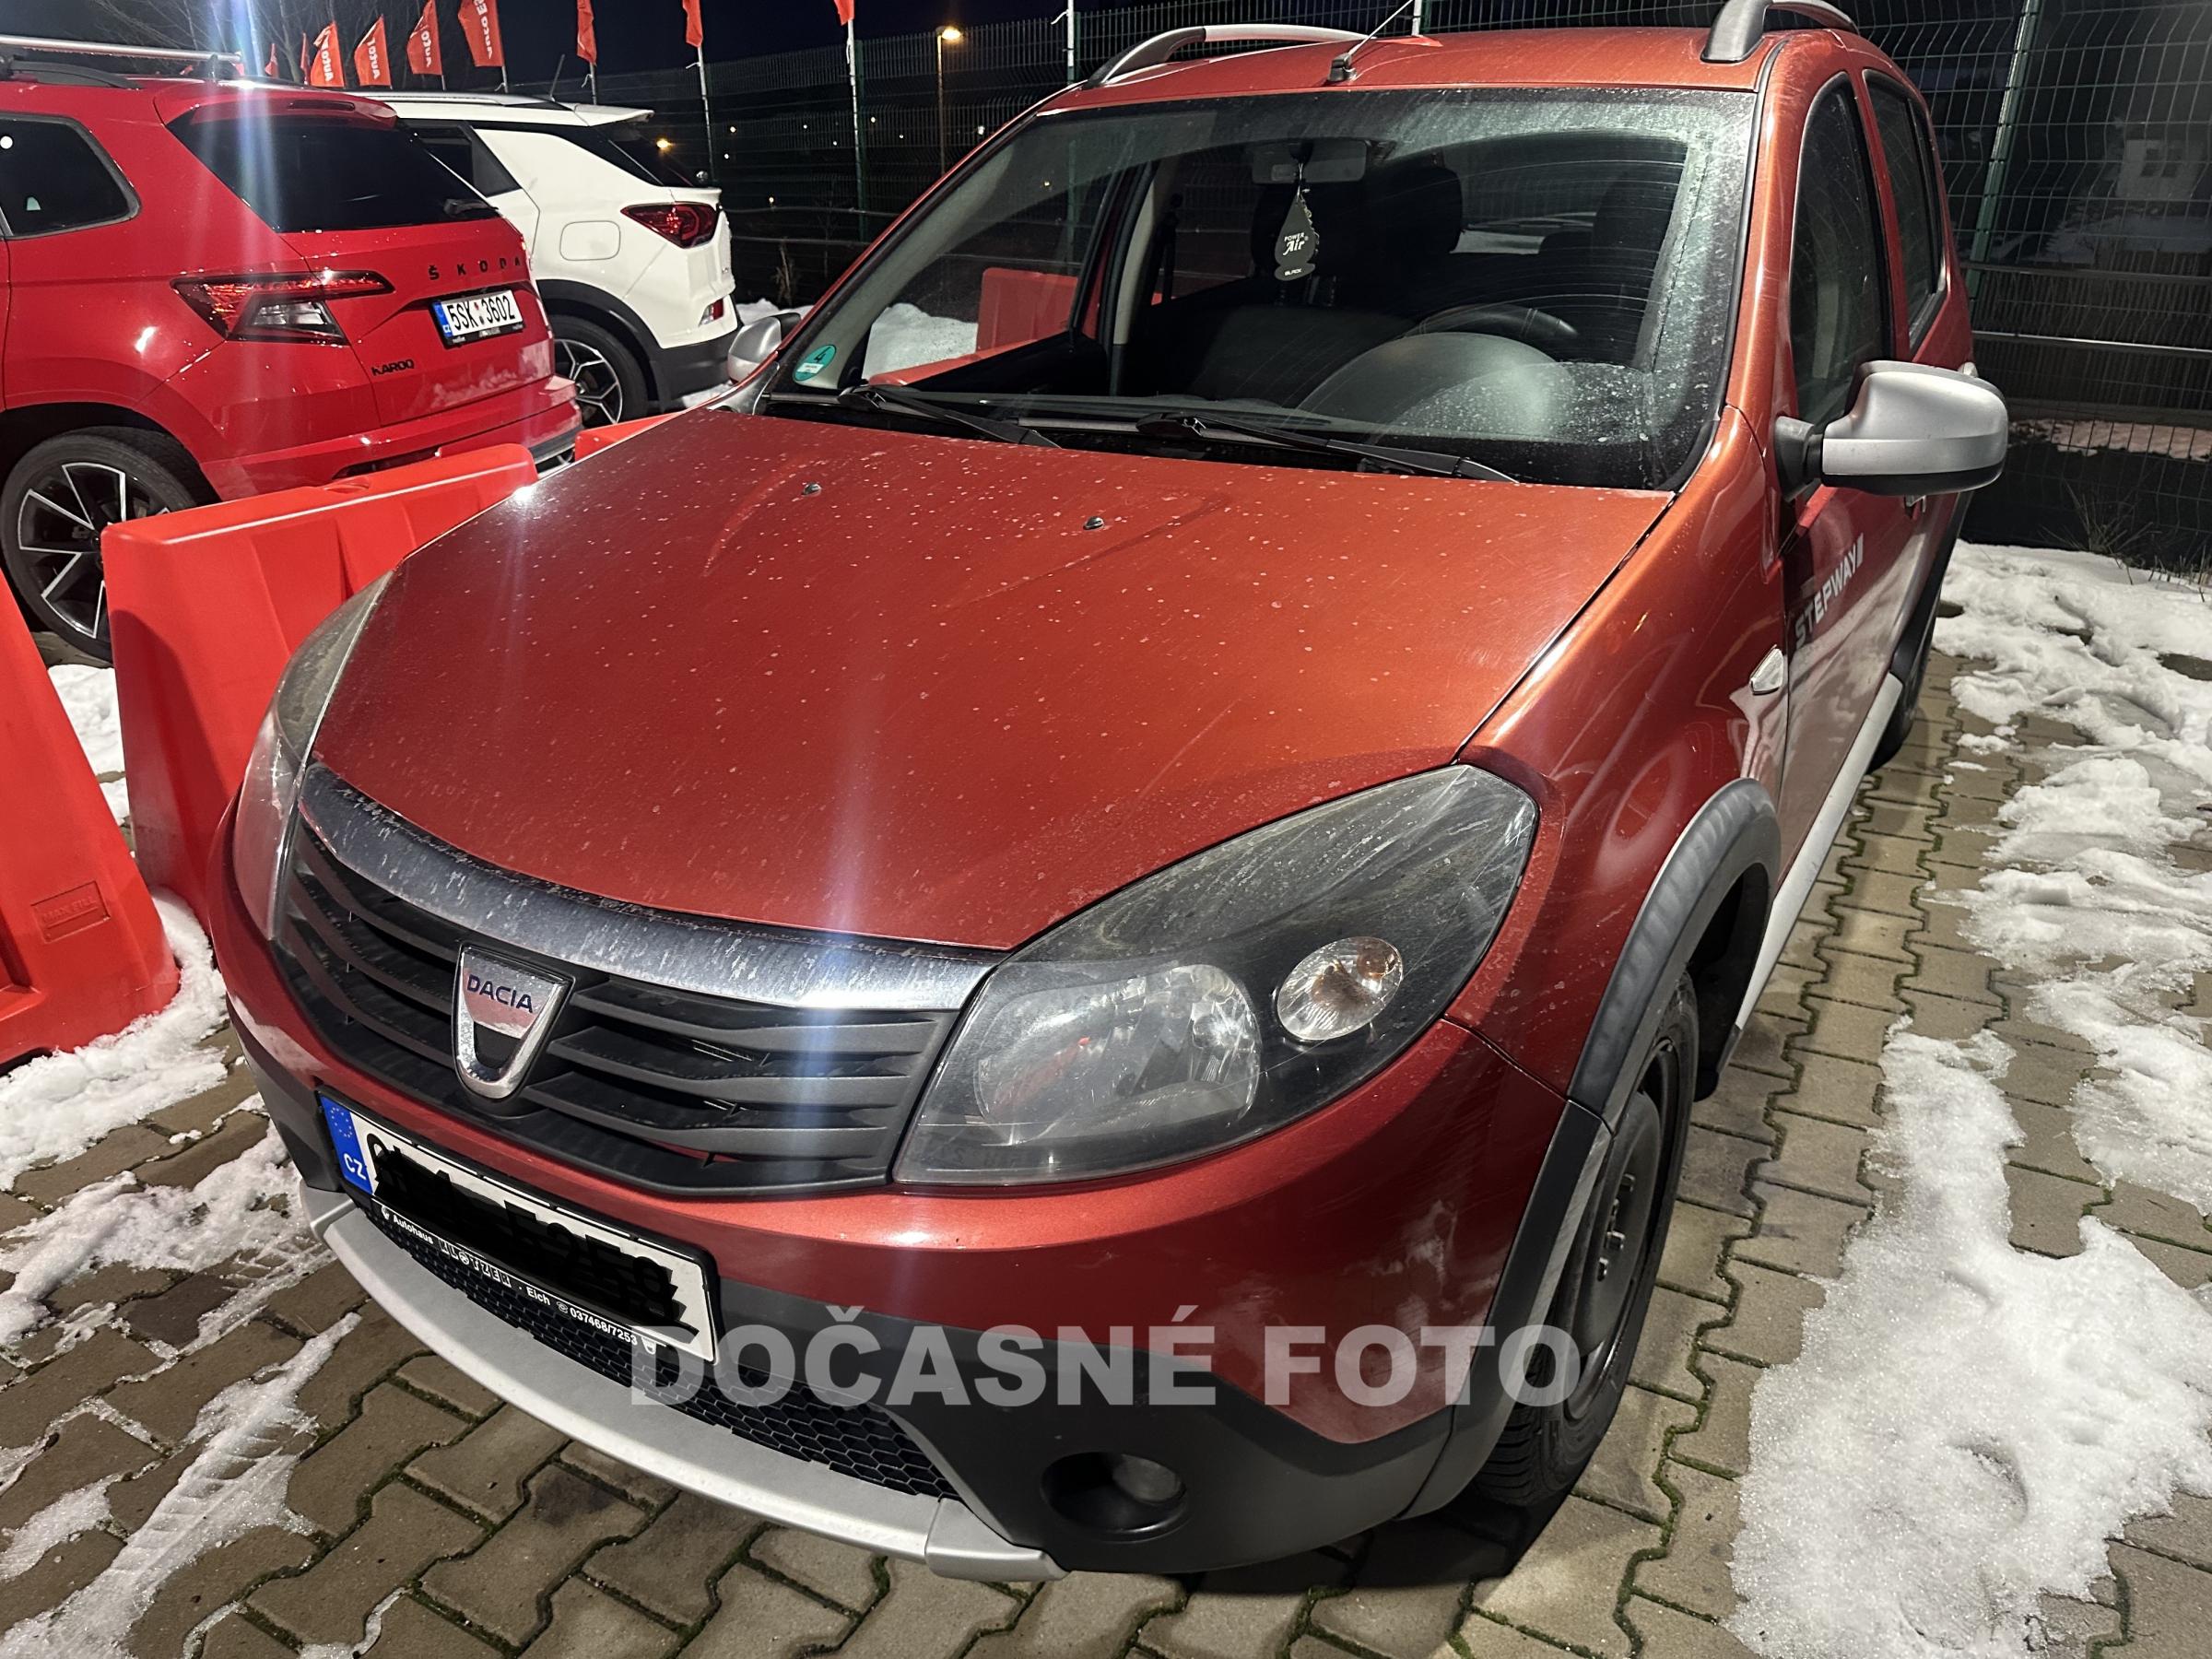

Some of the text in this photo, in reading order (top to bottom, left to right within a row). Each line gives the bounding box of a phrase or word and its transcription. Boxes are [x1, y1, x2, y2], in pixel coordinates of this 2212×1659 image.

[1283, 239, 1305, 255] Air
[429, 259, 521, 280] ŠKODA
[447, 294, 515, 331] 5SK 3602
[1794, 541, 1857, 649] STEPWAY
[466, 973, 533, 1013] DACIA
[344, 1153, 367, 1181] CZ
[393, 1215, 434, 1244] Autohaus
[570, 1307, 638, 1346] 037468/7253
